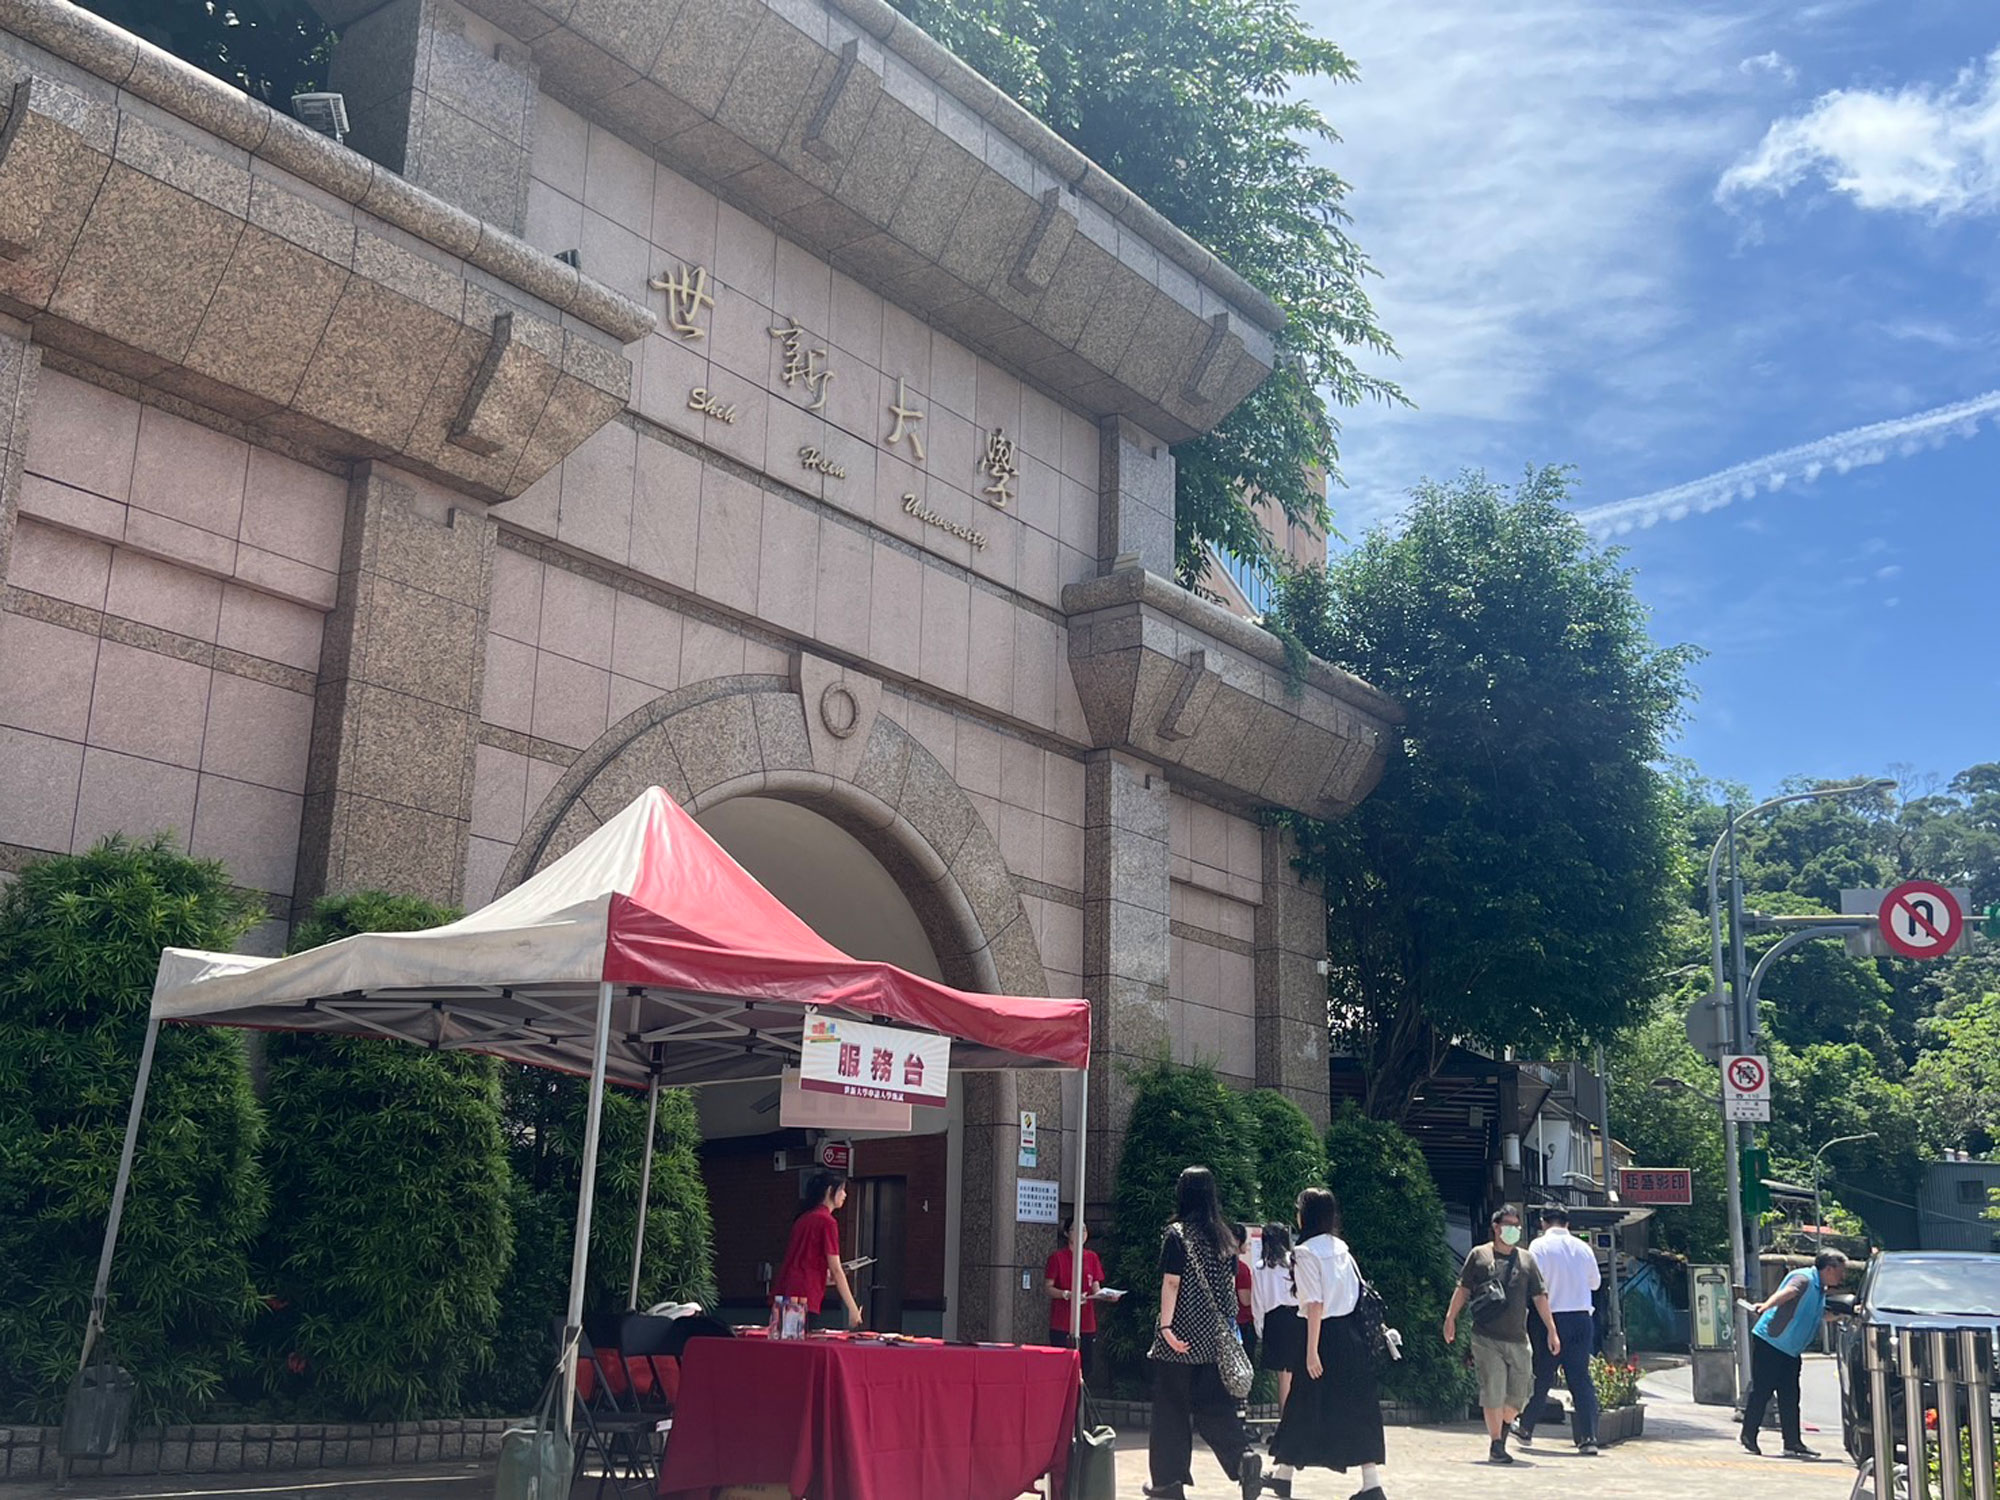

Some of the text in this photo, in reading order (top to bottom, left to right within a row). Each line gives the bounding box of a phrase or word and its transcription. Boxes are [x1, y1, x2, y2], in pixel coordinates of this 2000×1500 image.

[688, 387, 987, 552] Shih Hsin University
[838, 1042, 925, 1087] 服務台
